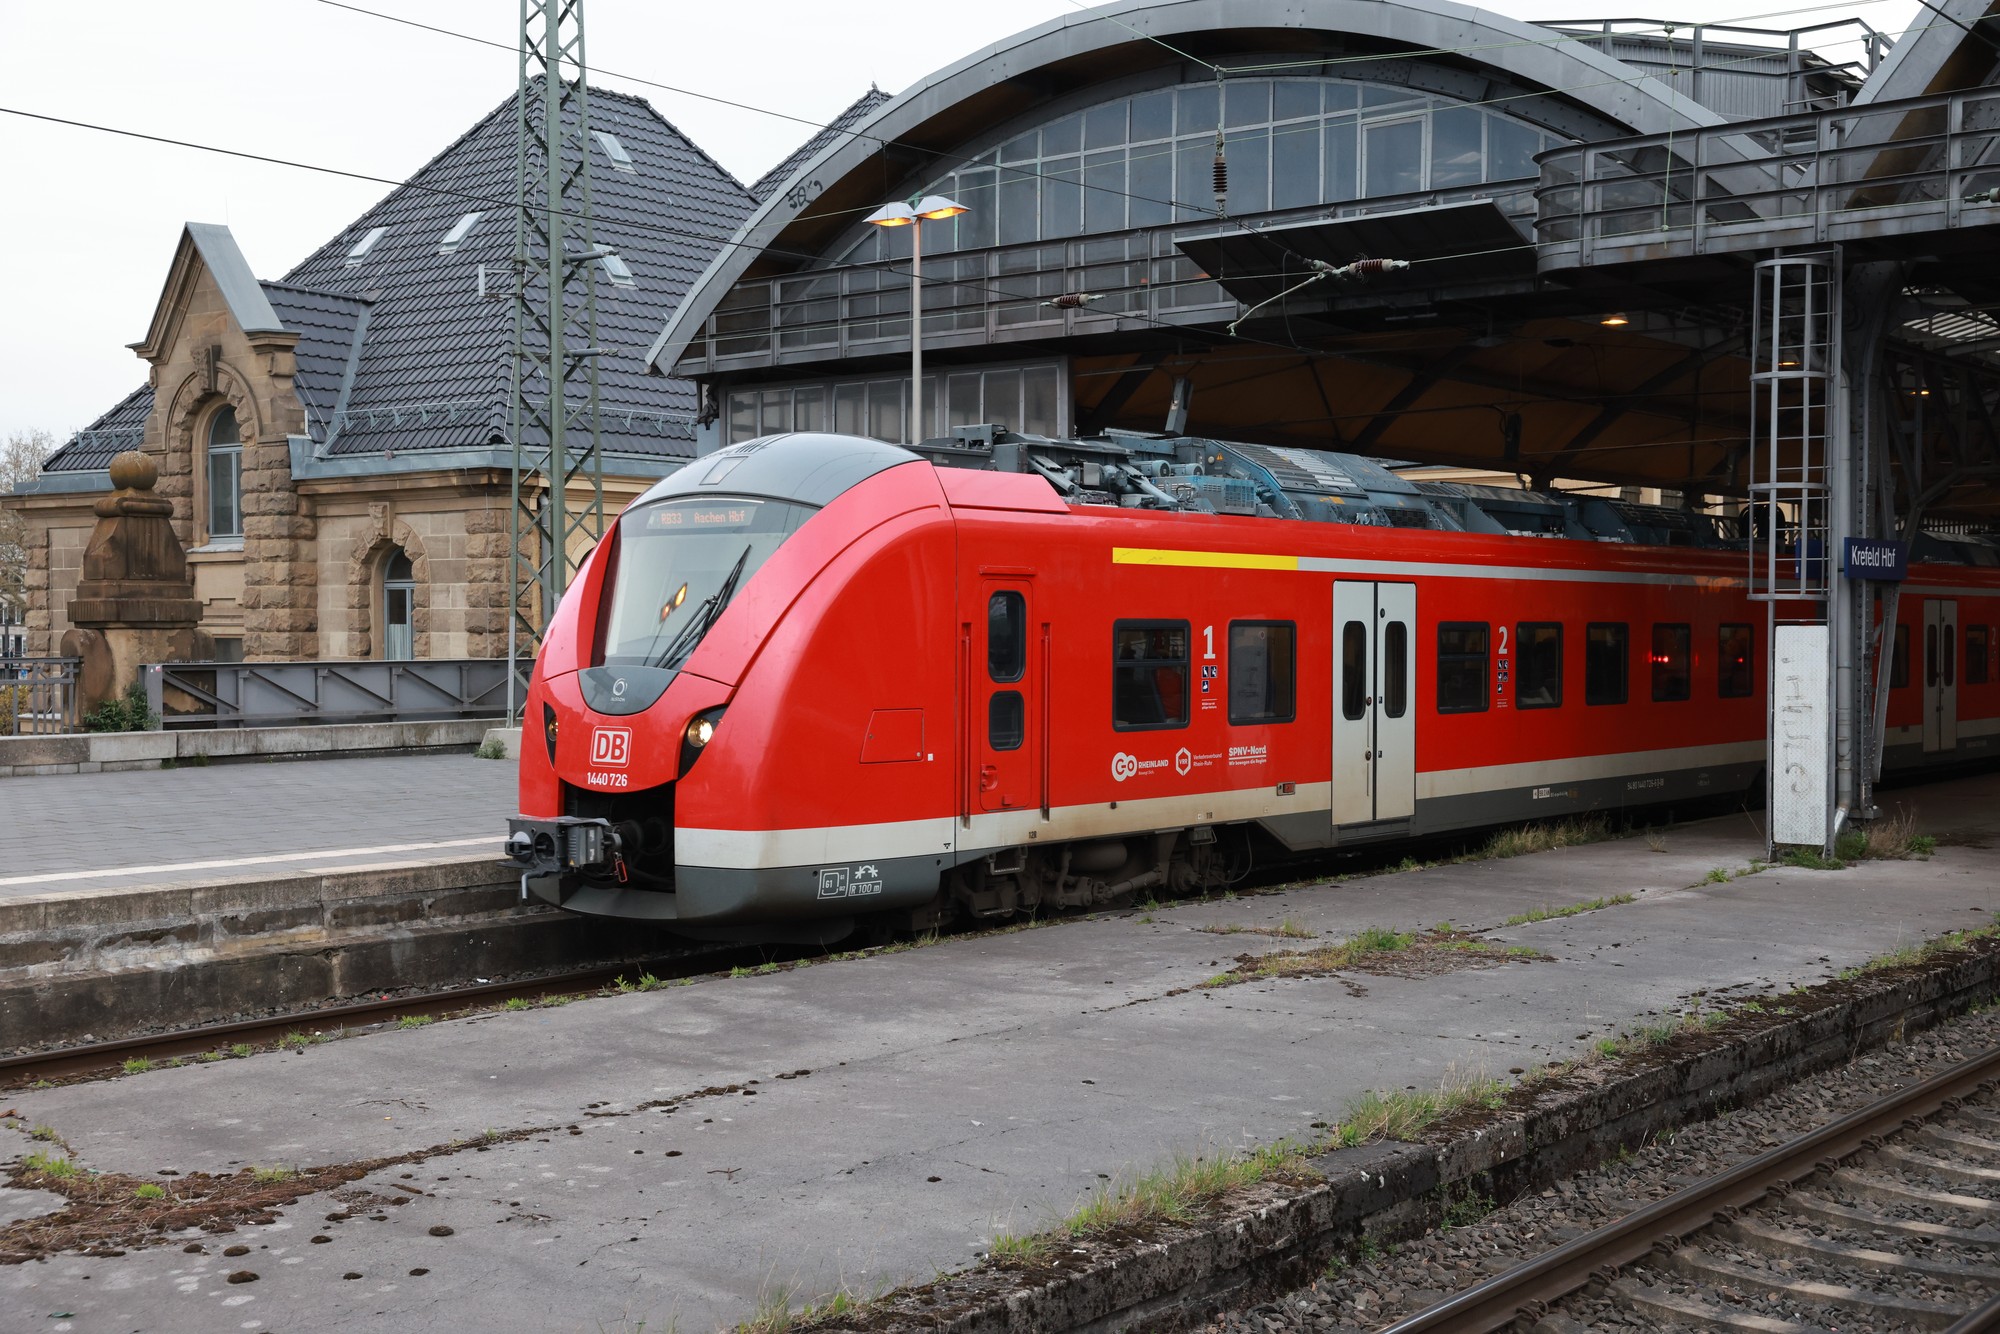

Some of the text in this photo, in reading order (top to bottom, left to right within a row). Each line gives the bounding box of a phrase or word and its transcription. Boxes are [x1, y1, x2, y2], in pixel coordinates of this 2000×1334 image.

[661, 510, 745, 525] RB33 Aachen Hbf
[1851, 545, 1896, 567] Krefeld Hbf
[1203, 625, 1216, 660] 1
[1498, 625, 1508, 655] 2
[595, 731, 628, 762] DB
[1229, 745, 1267, 756] SPNV-Nord
[1138, 759, 1169, 769] RHEINLAND
[1178, 758, 1188, 766] VRR
[587, 772, 628, 787] 1440 726
[858, 883, 872, 894] 100
[873, 884, 880, 892] m
